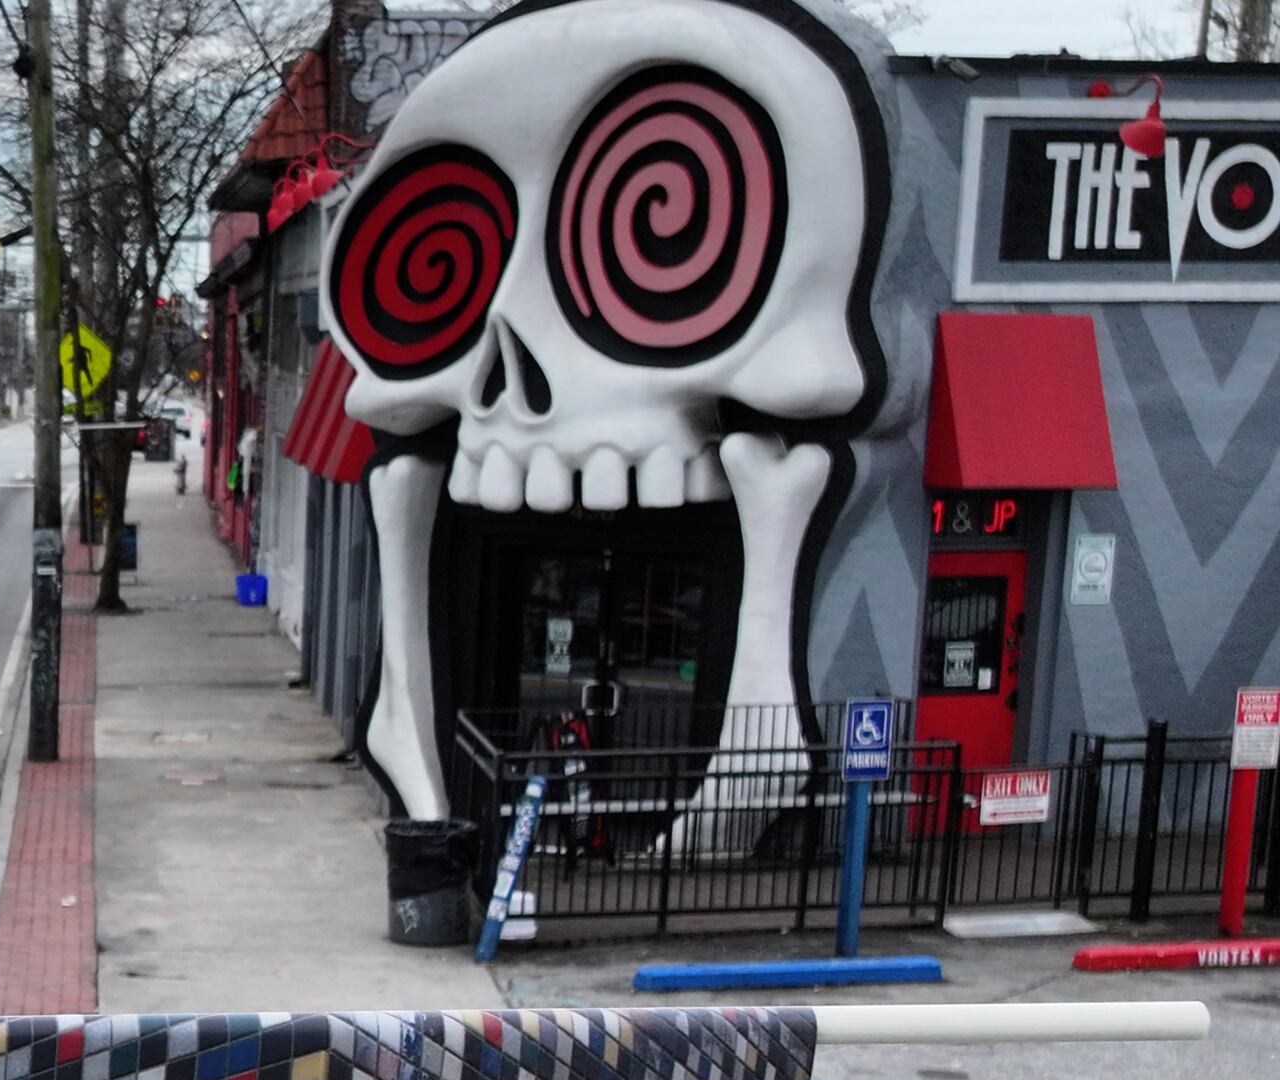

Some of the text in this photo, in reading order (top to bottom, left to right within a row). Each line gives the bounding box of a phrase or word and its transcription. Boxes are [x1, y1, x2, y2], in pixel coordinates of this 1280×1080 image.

[1046, 141, 1151, 260] THE
[984, 499, 1017, 534] JP
[846, 752, 887, 768] PARKING
[985, 774, 1047, 796] EXIT ONLY
[1197, 947, 1261, 967] VORTEX
